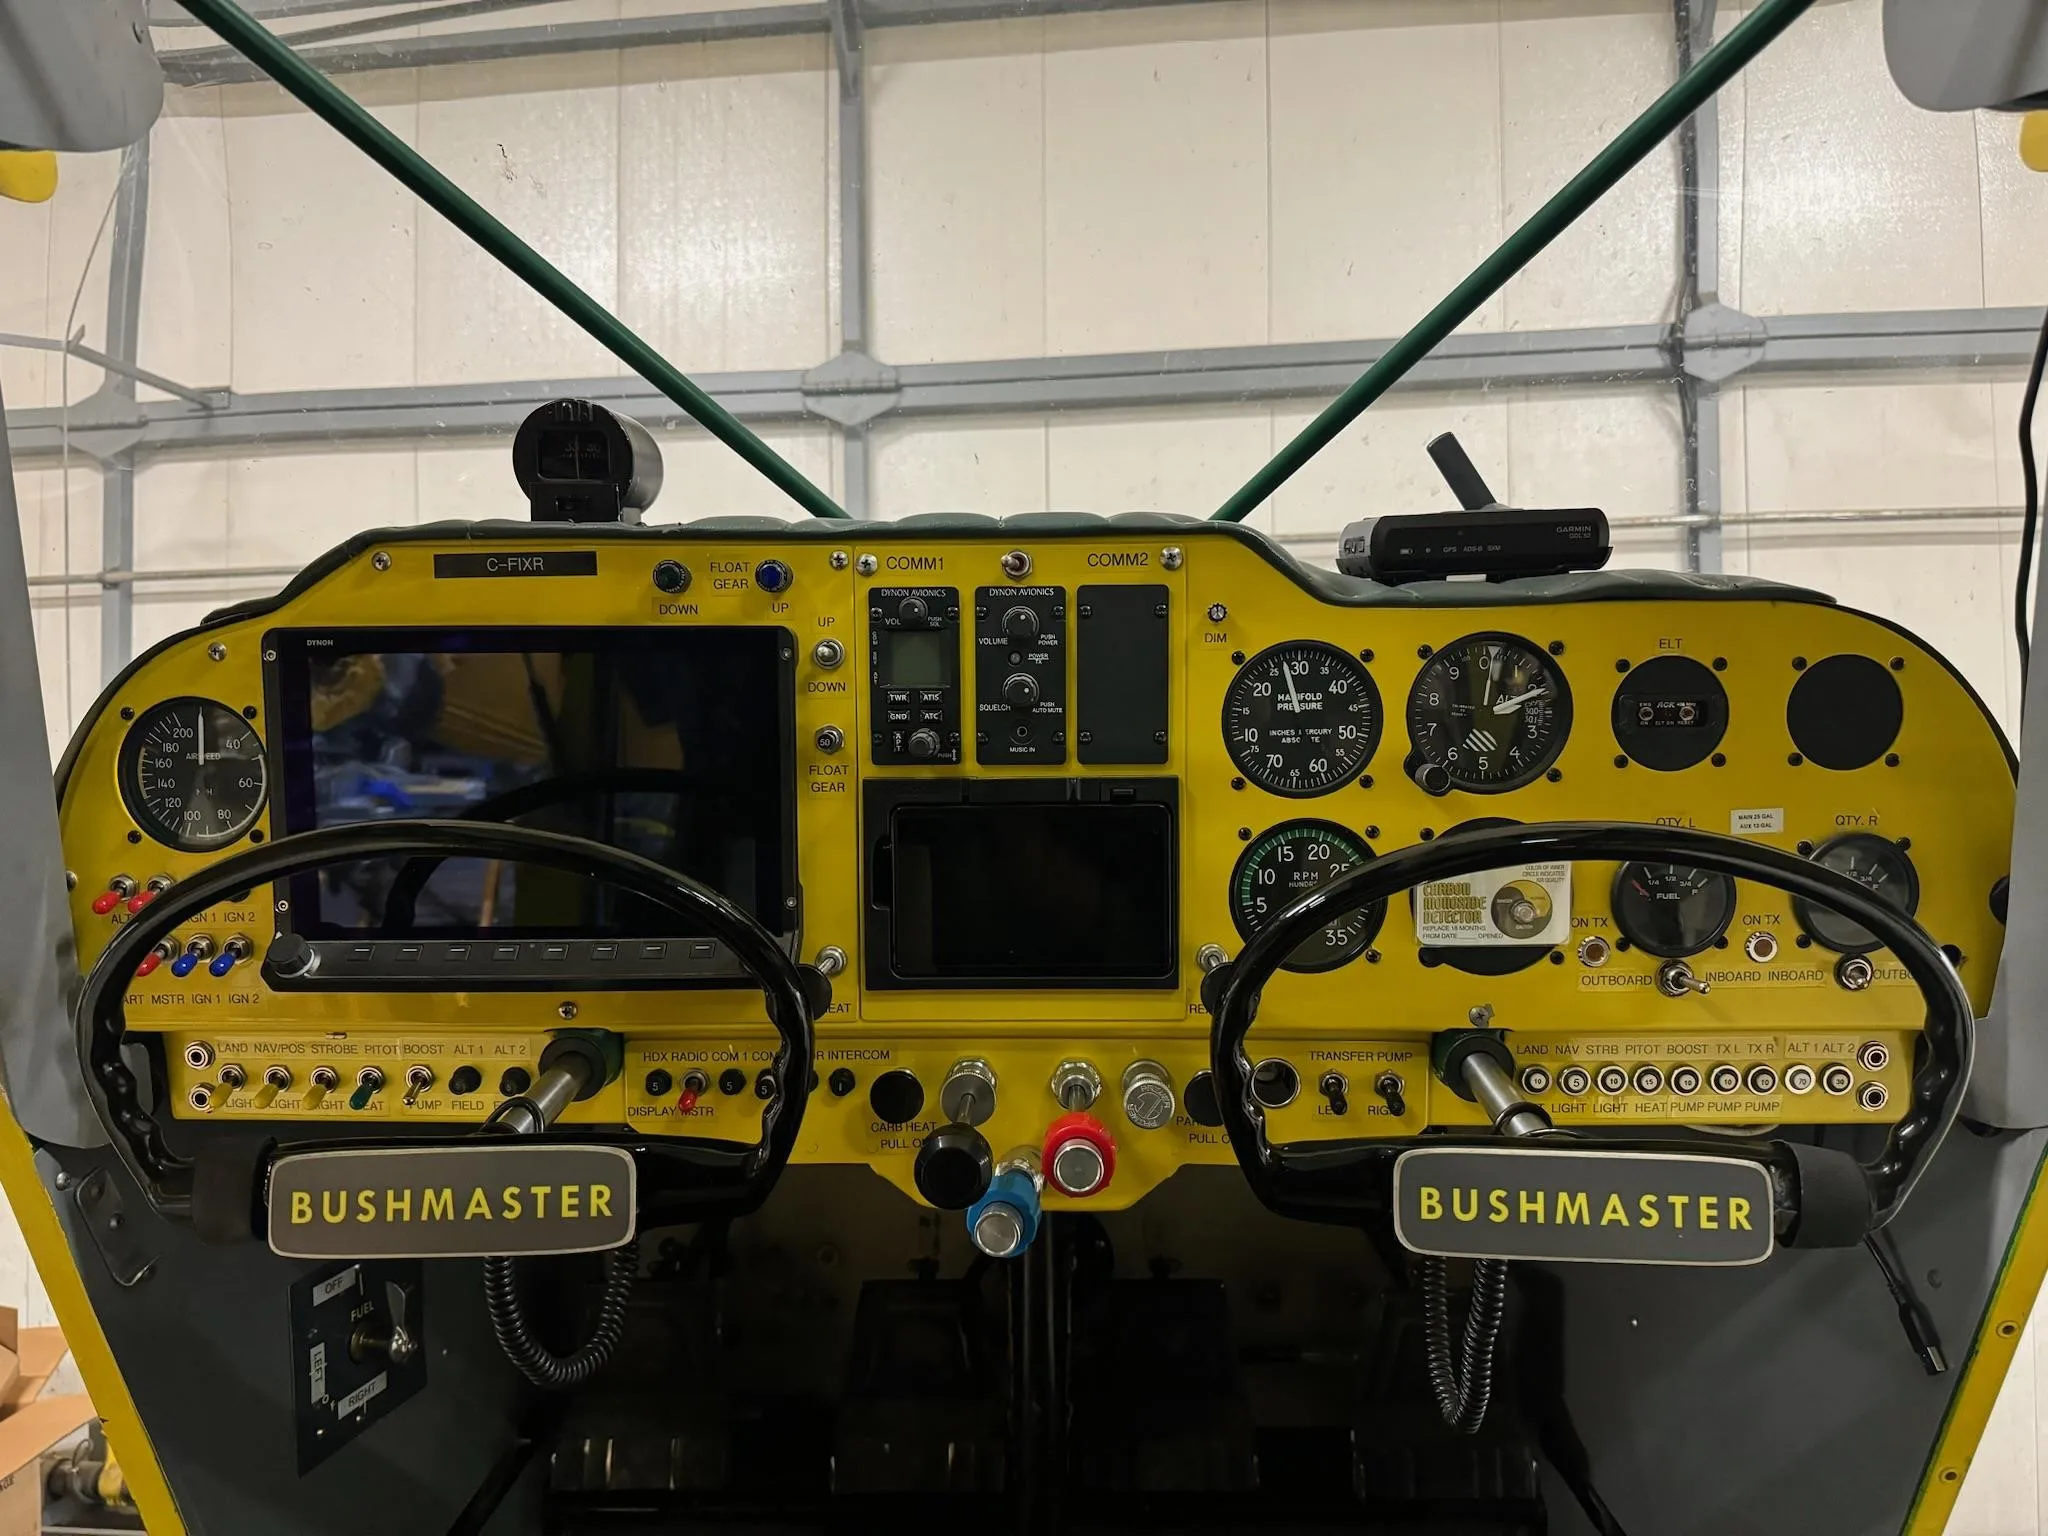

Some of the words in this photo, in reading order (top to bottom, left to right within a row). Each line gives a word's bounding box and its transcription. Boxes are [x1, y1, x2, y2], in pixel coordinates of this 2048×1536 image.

[1556, 526, 1592, 534] GARMIN
[486, 557, 544, 572] C-FIXR
[886, 556, 944, 571] COMM1
[1087, 552, 1149, 567] COMM2
[710, 562, 750, 573] FLOAT
[713, 579, 749, 590] GEAR
[881, 589, 909, 597] DYNON
[911, 588, 947, 597] AVIONICS
[989, 588, 1017, 597] DYNON
[1019, 588, 1054, 596] AVIONICS
[659, 604, 698, 615] DOWN
[772, 603, 789, 613] UP
[818, 617, 835, 627] UP
[978, 637, 1008, 645] VOLUME
[1204, 633, 1227, 643] DIM
[1659, 638, 1683, 649] ELT
[1290, 660, 1309, 675] 30
[1479, 656, 1489, 670] 0
[1269, 668, 1279, 677] 25
[1319, 667, 1330, 675] 35
[1449, 667, 1460, 680] 9
[807, 681, 846, 693] DOWN
[1253, 682, 1272, 697] 20
[1328, 679, 1347, 694] 40
[1429, 692, 1440, 706] 8
[1242, 707, 1250, 715] 15
[1348, 703, 1359, 712] 45
[173, 727, 194, 739] 200
[1269, 729, 1296, 737] INCHES
[1338, 725, 1357, 740] 50
[1427, 722, 1437, 736] 7
[1528, 725, 1538, 739] 3
[1244, 728, 1258, 742] 10
[162, 742, 180, 753] 180
[226, 739, 241, 750] 40
[819, 738, 831, 747] 50
[1335, 749, 1346, 757] 55
[1447, 747, 1458, 761] 6
[1509, 746, 1521, 758] 4
[155, 758, 173, 769] 160
[1266, 754, 1283, 768] 70
[1309, 758, 1328, 773] 60
[1478, 756, 1489, 770] 5
[809, 765, 849, 776] FLOAT
[1290, 769, 1300, 777] 65
[157, 778, 176, 789] 140
[238, 777, 253, 788] 60
[811, 782, 845, 793] GEAR
[165, 797, 182, 808] 120
[183, 811, 201, 821] 100
[217, 809, 232, 820] 80
[1689, 817, 1697, 828] L
[1835, 815, 1865, 826] QTY.
[1869, 815, 1878, 826] R
[1277, 846, 1295, 862] 15
[1307, 844, 1330, 861] 20
[1258, 868, 1276, 884] 10
[1422, 882, 1471, 897] CARBON
[1256, 897, 1268, 913] 5
[1422, 896, 1487, 910] MONOXIDE
[224, 912, 245, 922] IGN
[248, 912, 255, 922] 2
[1422, 910, 1483, 924] DETECTOR
[1571, 917, 1589, 928] ON
[1592, 917, 1608, 928] TX
[1742, 915, 1761, 926] ON
[1764, 914, 1780, 925] TX
[1325, 929, 1348, 946] 35
[1581, 975, 1653, 986] OUTBOARD
[1705, 971, 1761, 982] INBOARD
[1768, 970, 1824, 981] INBOARD
[151, 994, 185, 1005] MSTR
[191, 995, 212, 1004] IGN
[228, 995, 250, 1004] IGN
[252, 995, 260, 1004] 2
[217, 1043, 248, 1053] LAND
[254, 1043, 305, 1054] NAV/POS
[311, 1044, 358, 1054] STROBE
[364, 1044, 399, 1055] PITOT
[403, 1044, 445, 1054] BOOST
[454, 1044, 475, 1054] ALT
[494, 1045, 515, 1054] ALT
[518, 1045, 526, 1054] 2
[1516, 1044, 1549, 1055] LAND
[1555, 1045, 1580, 1054] NAV
[1586, 1044, 1619, 1054] STRB
[1625, 1044, 1660, 1054] PITOT
[1667, 1044, 1709, 1054] BOOST
[1716, 1044, 1731, 1054] TX
[1734, 1044, 1739, 1054] L
[1747, 1044, 1762, 1054] TX
[1765, 1044, 1774, 1054] R
[1787, 1043, 1810, 1053] ALT
[1822, 1043, 1844, 1053] ALT
[1847, 1043, 1855, 1053] 2
[643, 1052, 668, 1062] HDX
[671, 1052, 708, 1062] RADIO
[712, 1051, 739, 1062] COM
[828, 1050, 890, 1060] INTERCOM
[1308, 1051, 1374, 1062] TRANSFER
[1377, 1051, 1413, 1062] PUMP
[652, 1082, 659, 1091] 5
[726, 1081, 733, 1091] 5
[1573, 1078, 1580, 1088] 5
[761, 1085, 768, 1095] 5
[409, 1100, 442, 1110] PUMP
[451, 1100, 484, 1111] FIELD
[1551, 1103, 1587, 1113] LIGHT
[1593, 1103, 1629, 1113] LIGHT
[1635, 1103, 1668, 1112] HEAT
[1670, 1103, 1705, 1112] PUMP
[1707, 1102, 1742, 1112] PUMP
[1745, 1102, 1780, 1112] PUMP
[627, 1106, 676, 1117] DISPLAY
[871, 1122, 903, 1132] CARB
[906, 1121, 937, 1132] HEAT
[880, 1139, 910, 1149] PULL
[1189, 1133, 1217, 1144] PULL
[291, 1184, 614, 1224] BUSHMASTER
[1419, 1186, 1753, 1231] BUSHMASTER
[324, 1276, 343, 1294] OFF
[351, 1301, 375, 1322] FUEL
[313, 1352, 323, 1382] LEFT
[348, 1380, 377, 1408] RIGHT
